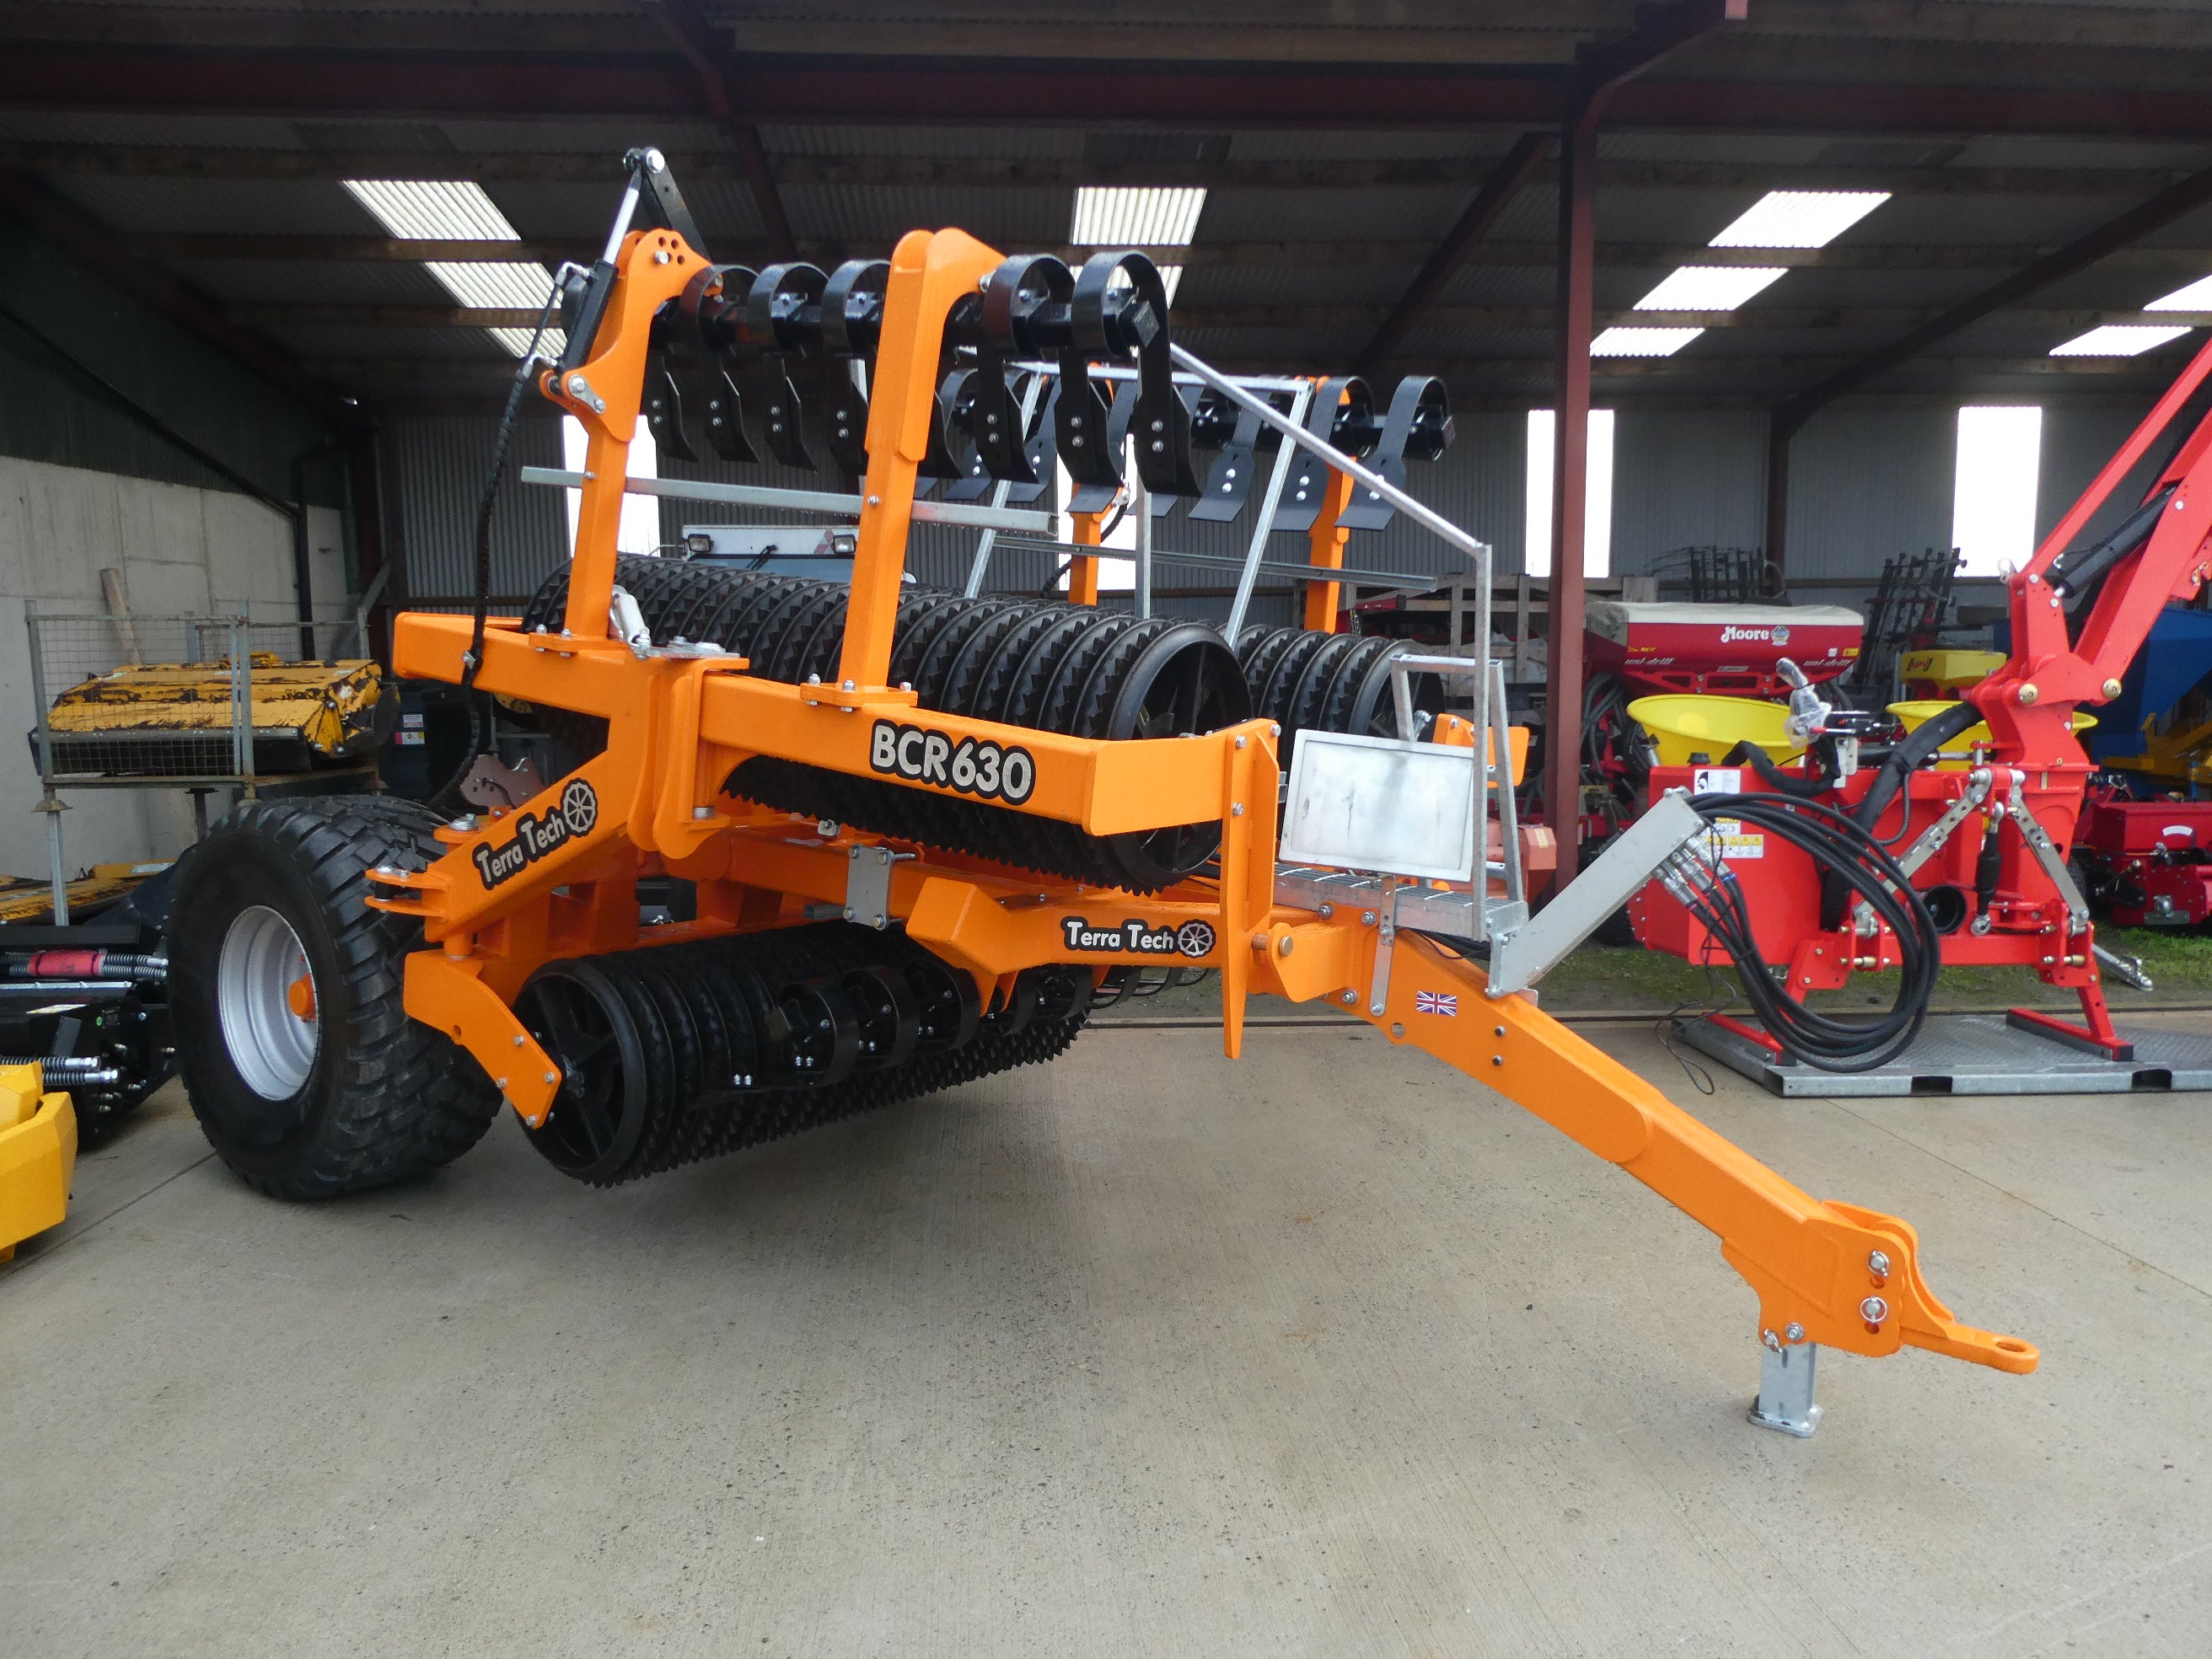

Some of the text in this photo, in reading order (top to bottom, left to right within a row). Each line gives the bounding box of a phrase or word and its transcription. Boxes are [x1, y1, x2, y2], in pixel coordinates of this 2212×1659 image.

[1721, 625, 1769, 643] Moore
[872, 724, 1032, 798] BCR630
[476, 813, 566, 883] Terra Tech
[1066, 921, 1174, 950] Terra Tech
